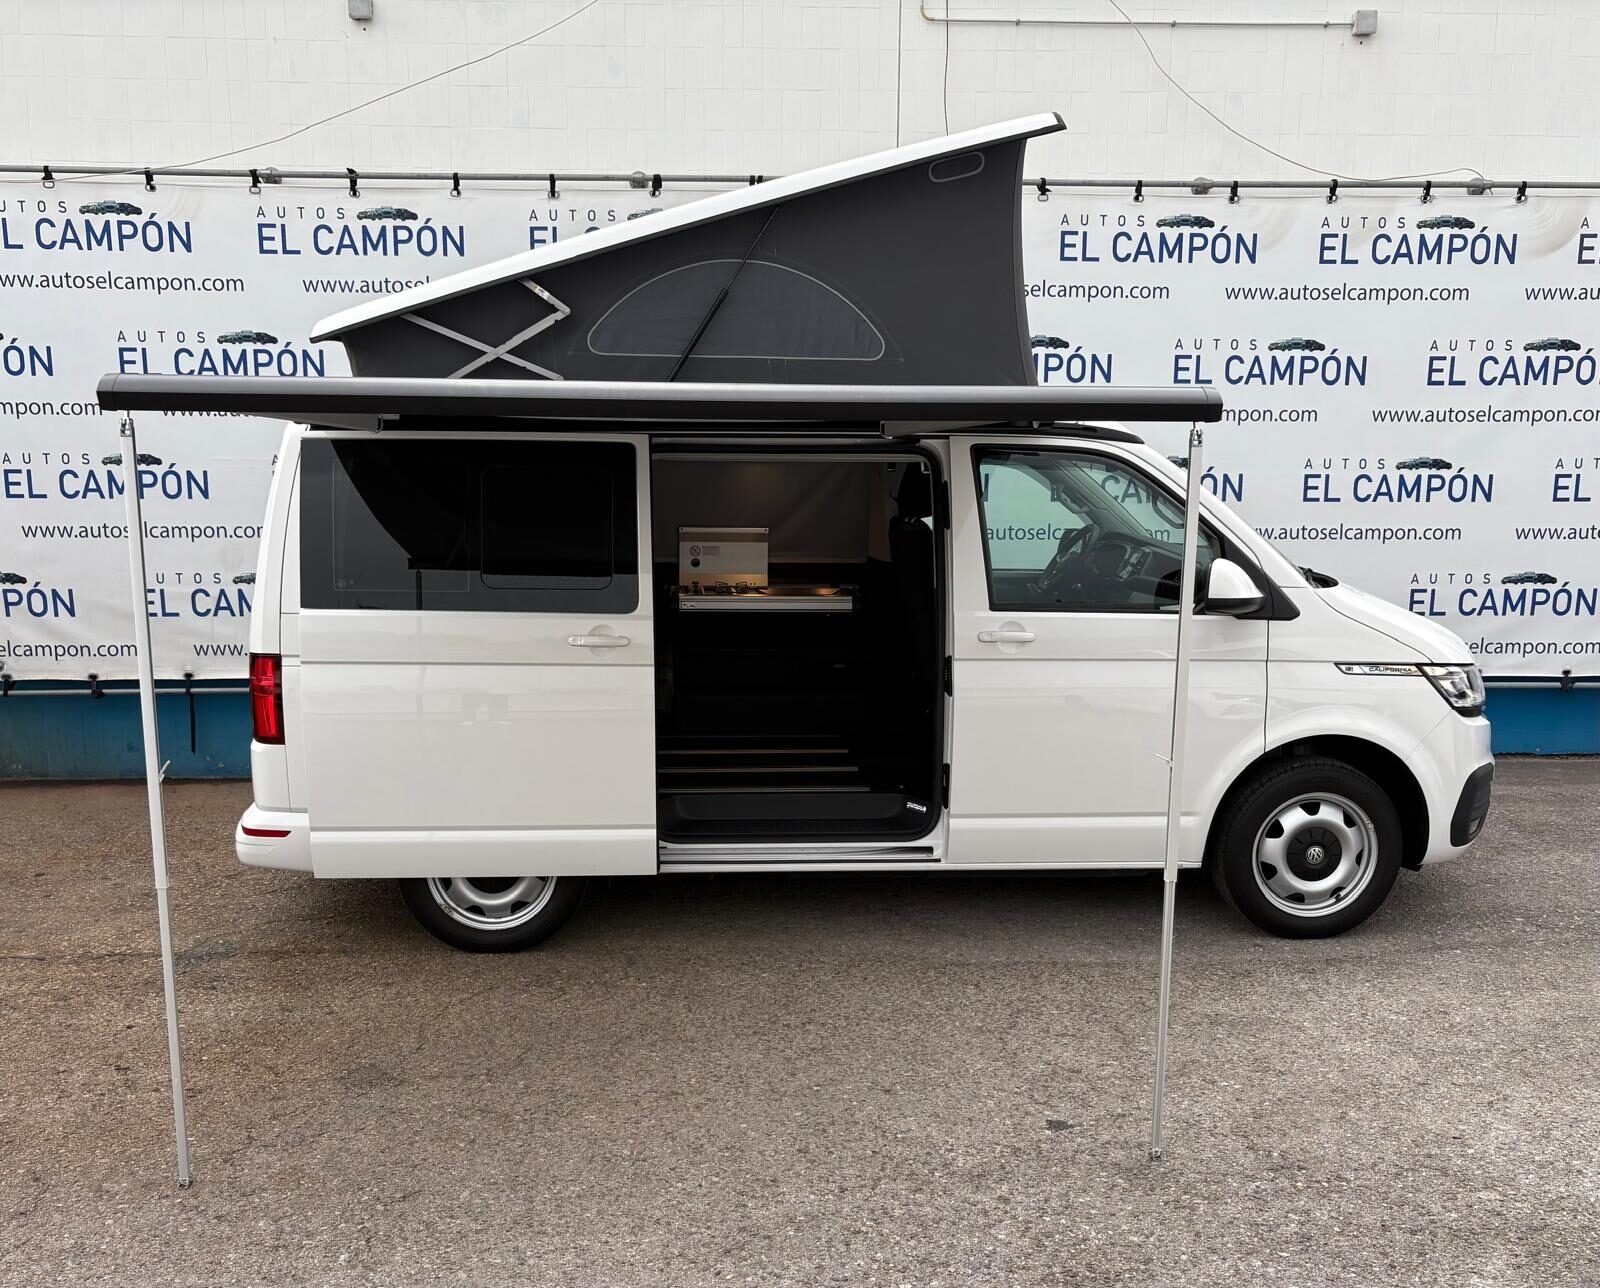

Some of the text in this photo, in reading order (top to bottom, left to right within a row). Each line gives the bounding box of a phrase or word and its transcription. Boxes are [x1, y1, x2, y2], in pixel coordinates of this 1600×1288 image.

[257, 206, 344, 219] AUTOS
[529, 209, 615, 221] AUTOS
[1061, 214, 1144, 227] AUTOS
[1321, 216, 1405, 229] AUTOS
[35, 213, 192, 253] CAMPÓN
[258, 218, 464, 257] EL CAMPÓN
[1060, 225, 1257, 264] EL CAMPÓN
[1319, 226, 1517, 265] EL CAMPÓN
[1225, 283, 1469, 305] www.autoselcampon.com
[118, 330, 205, 343] AUTOS
[1175, 338, 1257, 350] AUTOS
[1430, 340, 1512, 351] AUTOS
[173, 342, 325, 376] CAMPÓN
[1173, 349, 1367, 386] EL CAMPÓN
[1427, 347, 1600, 386] EL CAMPÓ
[3, 453, 90, 465] AUTOS
[1304, 458, 1385, 469] AUTOS
[3, 469, 47, 499] EL
[1303, 467, 1493, 502] EL CAMPÓN
[1552, 474, 1591, 502] EL
[1411, 573, 1490, 584] AUTOS
[1409, 581, 1598, 617] EL CAMPÓN
